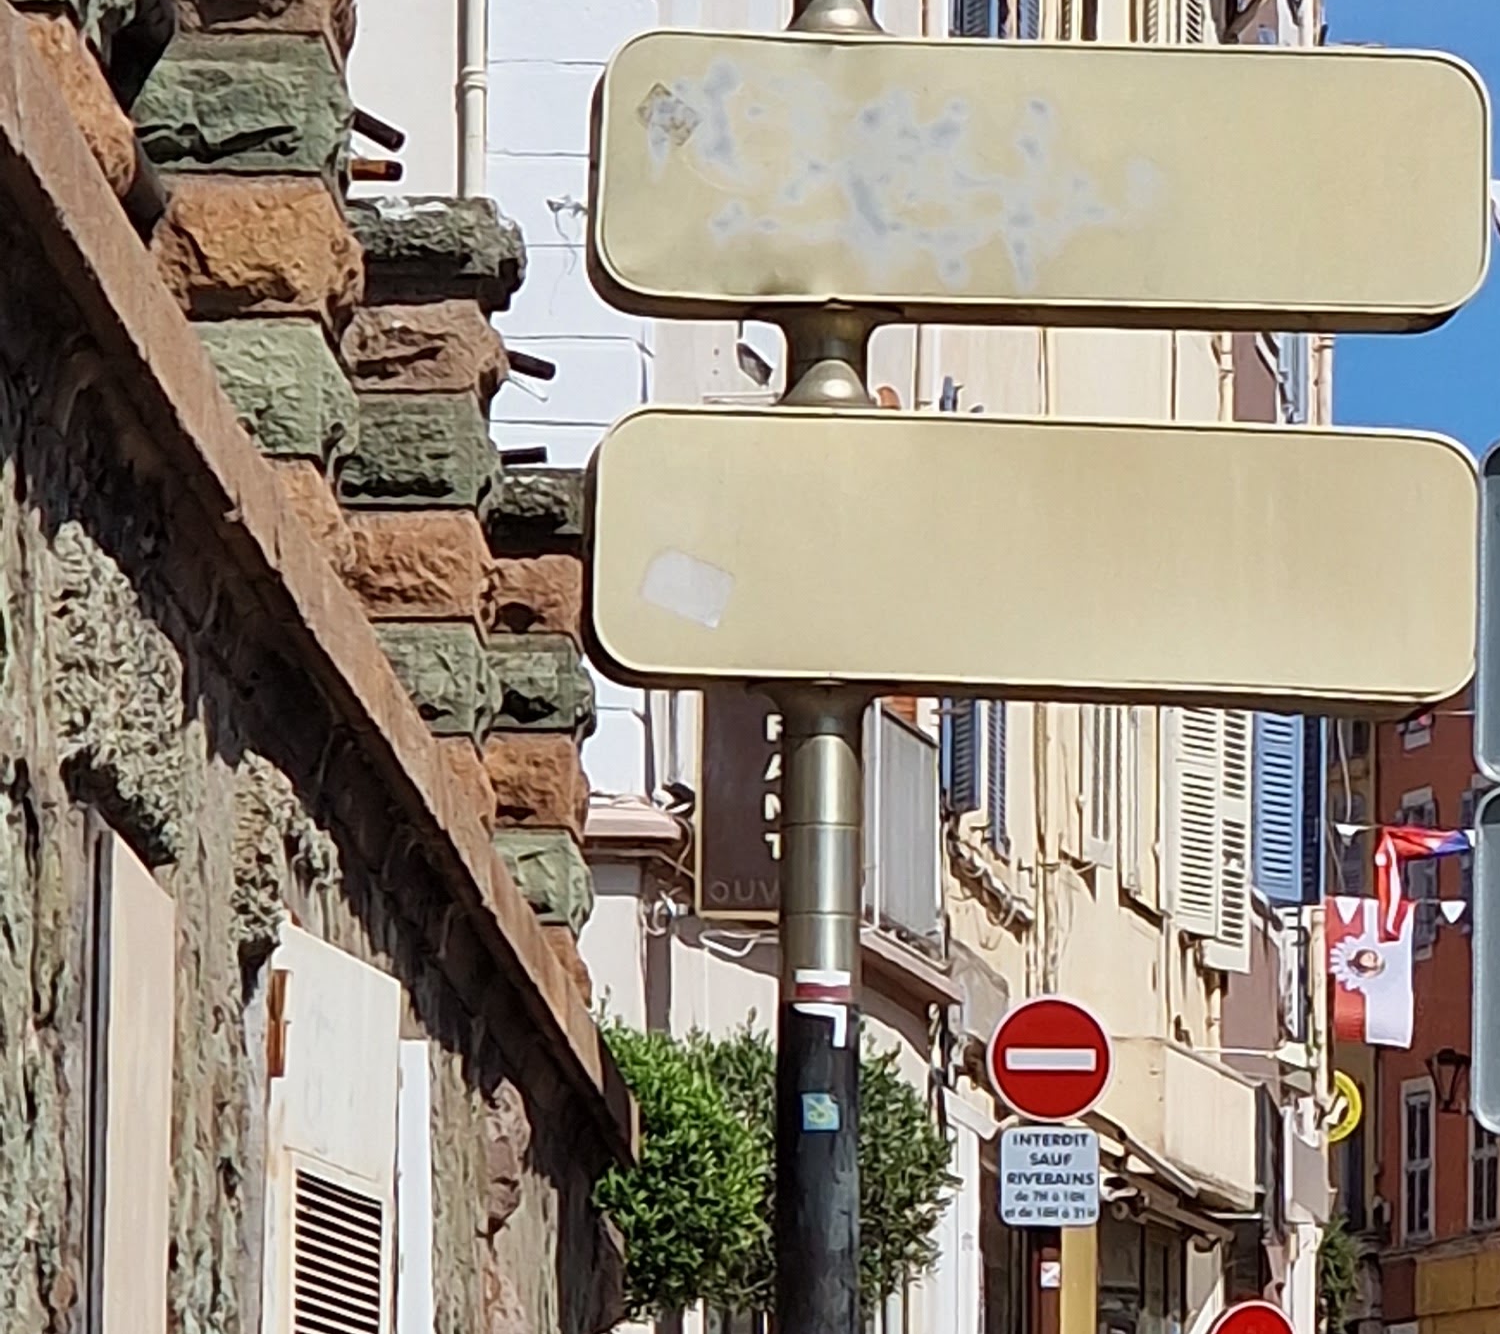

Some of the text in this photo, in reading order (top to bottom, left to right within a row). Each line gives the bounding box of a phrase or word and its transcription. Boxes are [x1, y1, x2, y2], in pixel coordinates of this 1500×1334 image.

[1013, 1134, 1088, 1146] INTERDIT
[1029, 1152, 1072, 1166] SAUF
[1007, 1172, 1095, 1185] RIVERAINS
